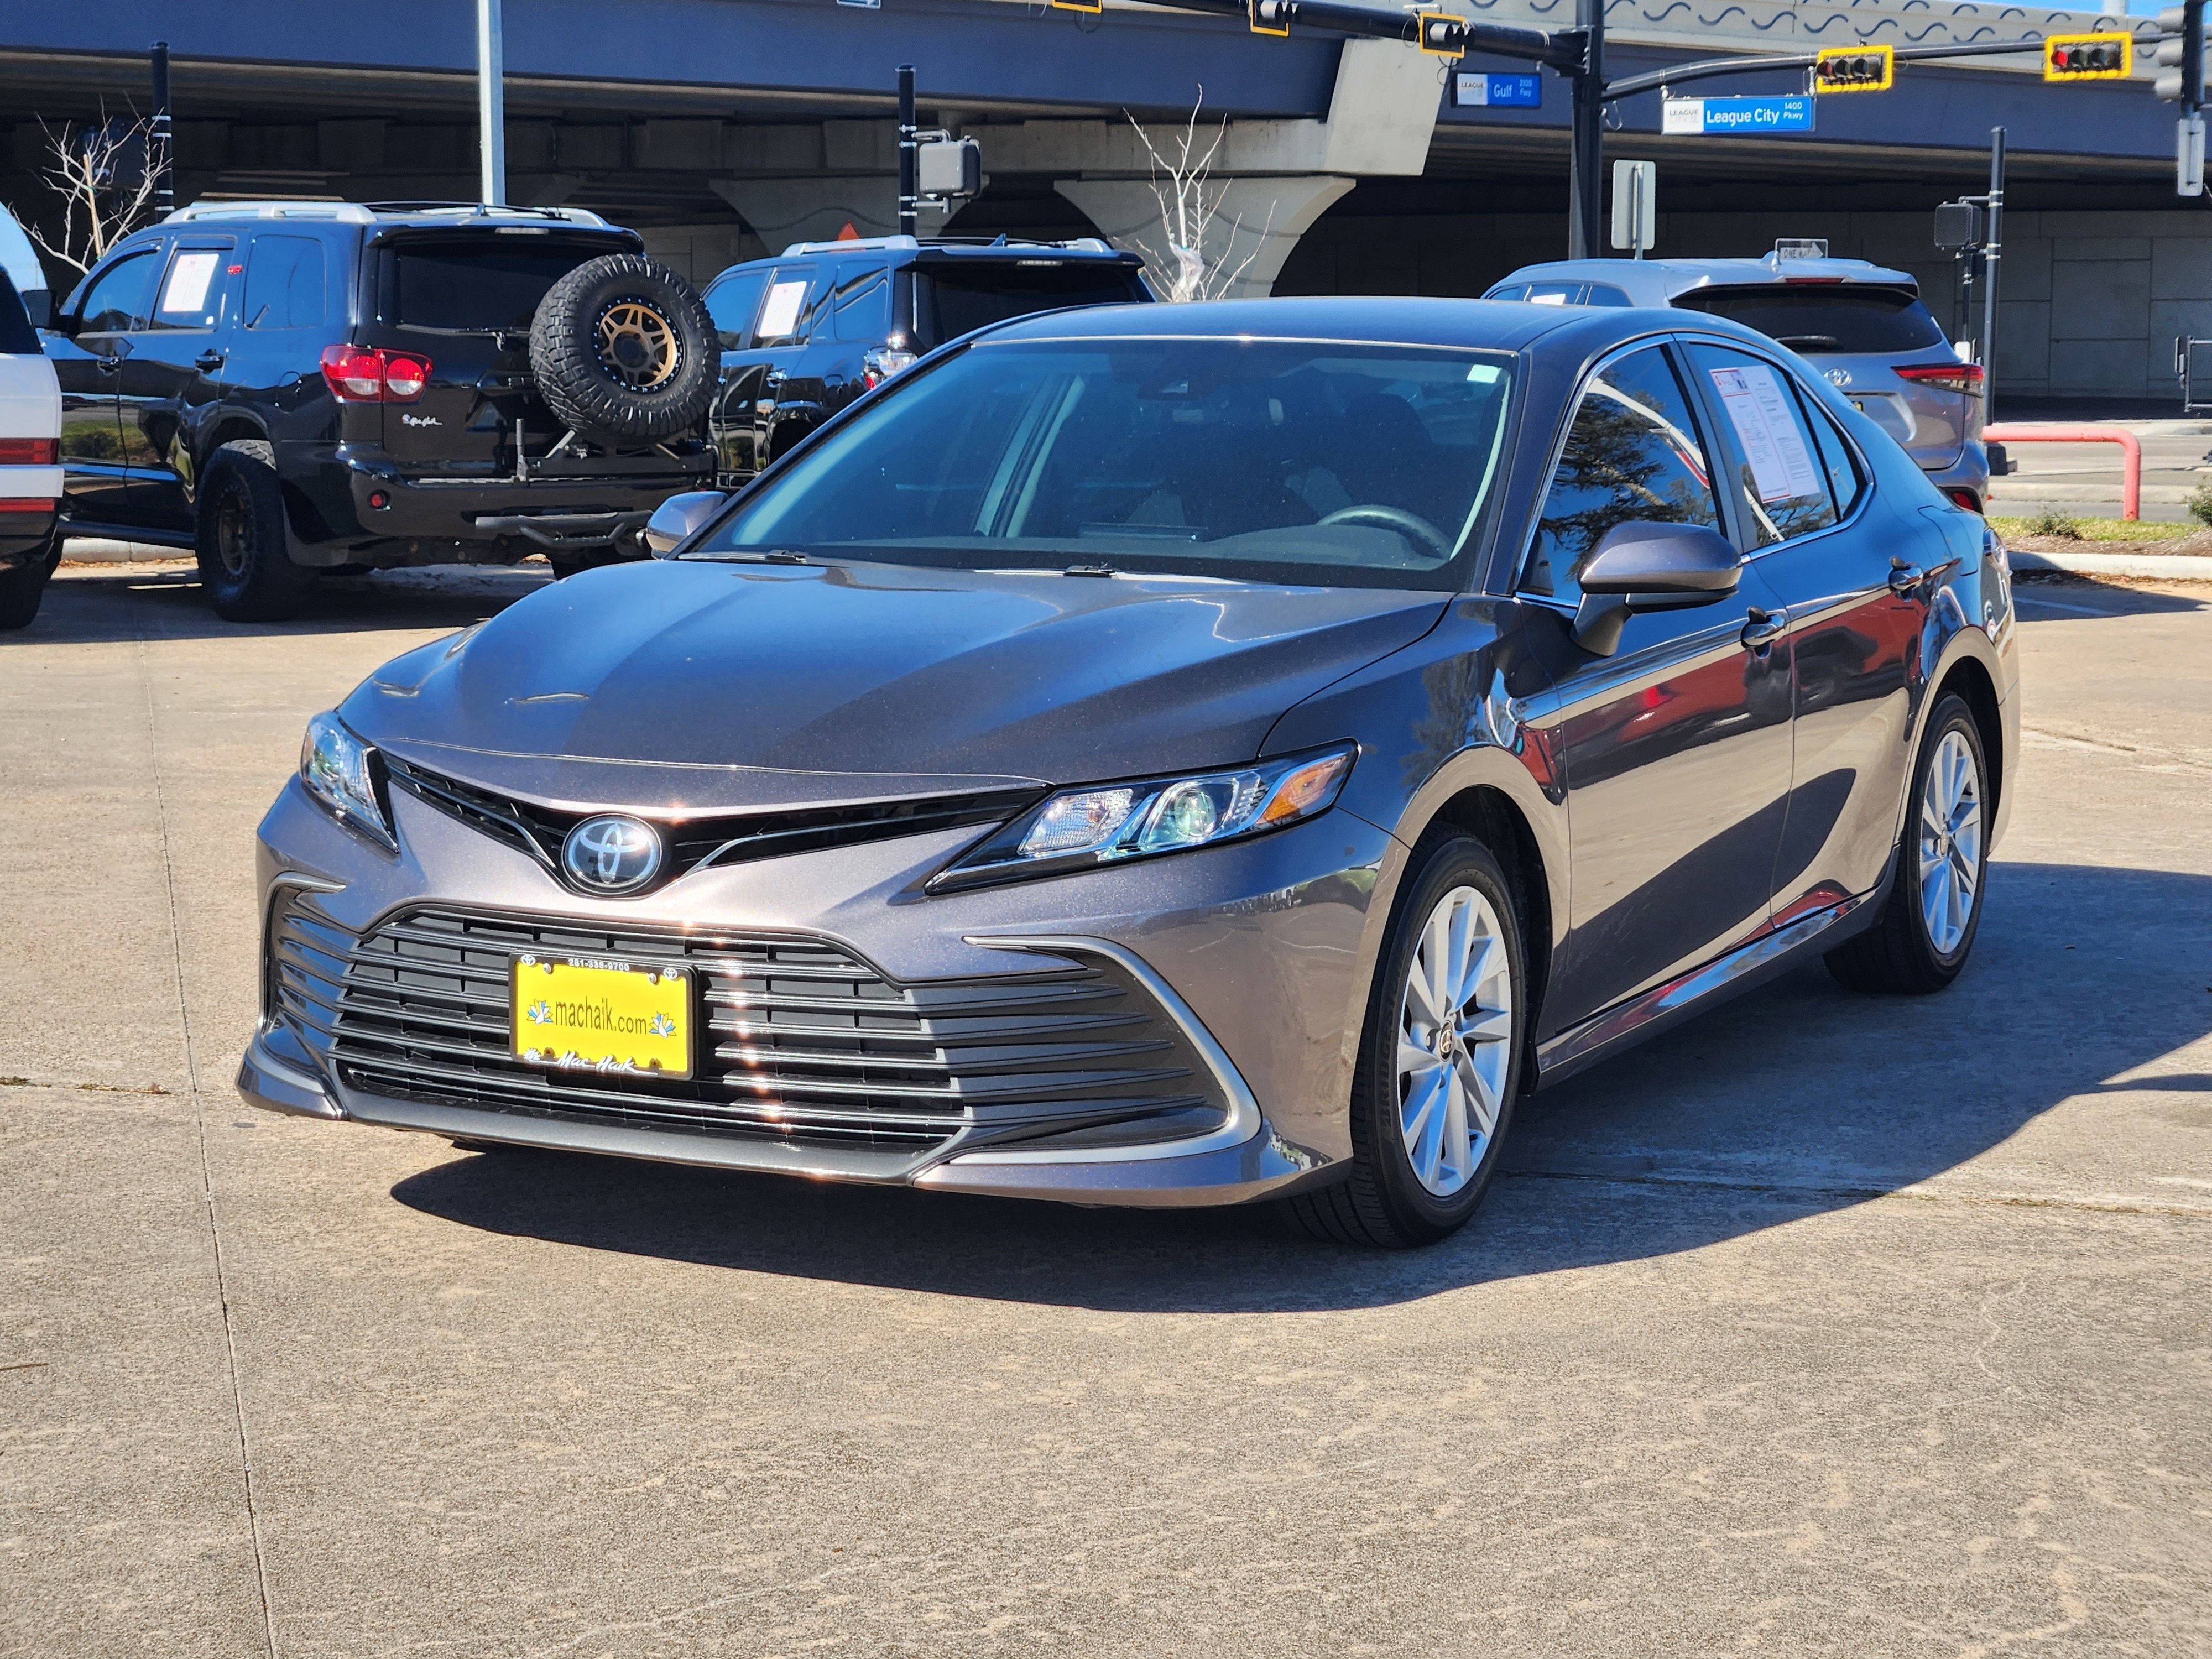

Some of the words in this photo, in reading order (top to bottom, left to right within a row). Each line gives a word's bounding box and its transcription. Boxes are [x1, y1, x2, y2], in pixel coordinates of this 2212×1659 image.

[1494, 84, 1512, 97] Gulf
[1520, 88, 1532, 98] Fwy
[1785, 101, 1803, 110] 1400
[1707, 110, 1752, 127] League
[1754, 108, 1780, 124] City
[1783, 111, 1803, 121] Pkwy
[1784, 248, 1797, 259] ONE
[556, 996, 647, 1035] machaik.com
[556, 1050, 594, 1068] Mac
